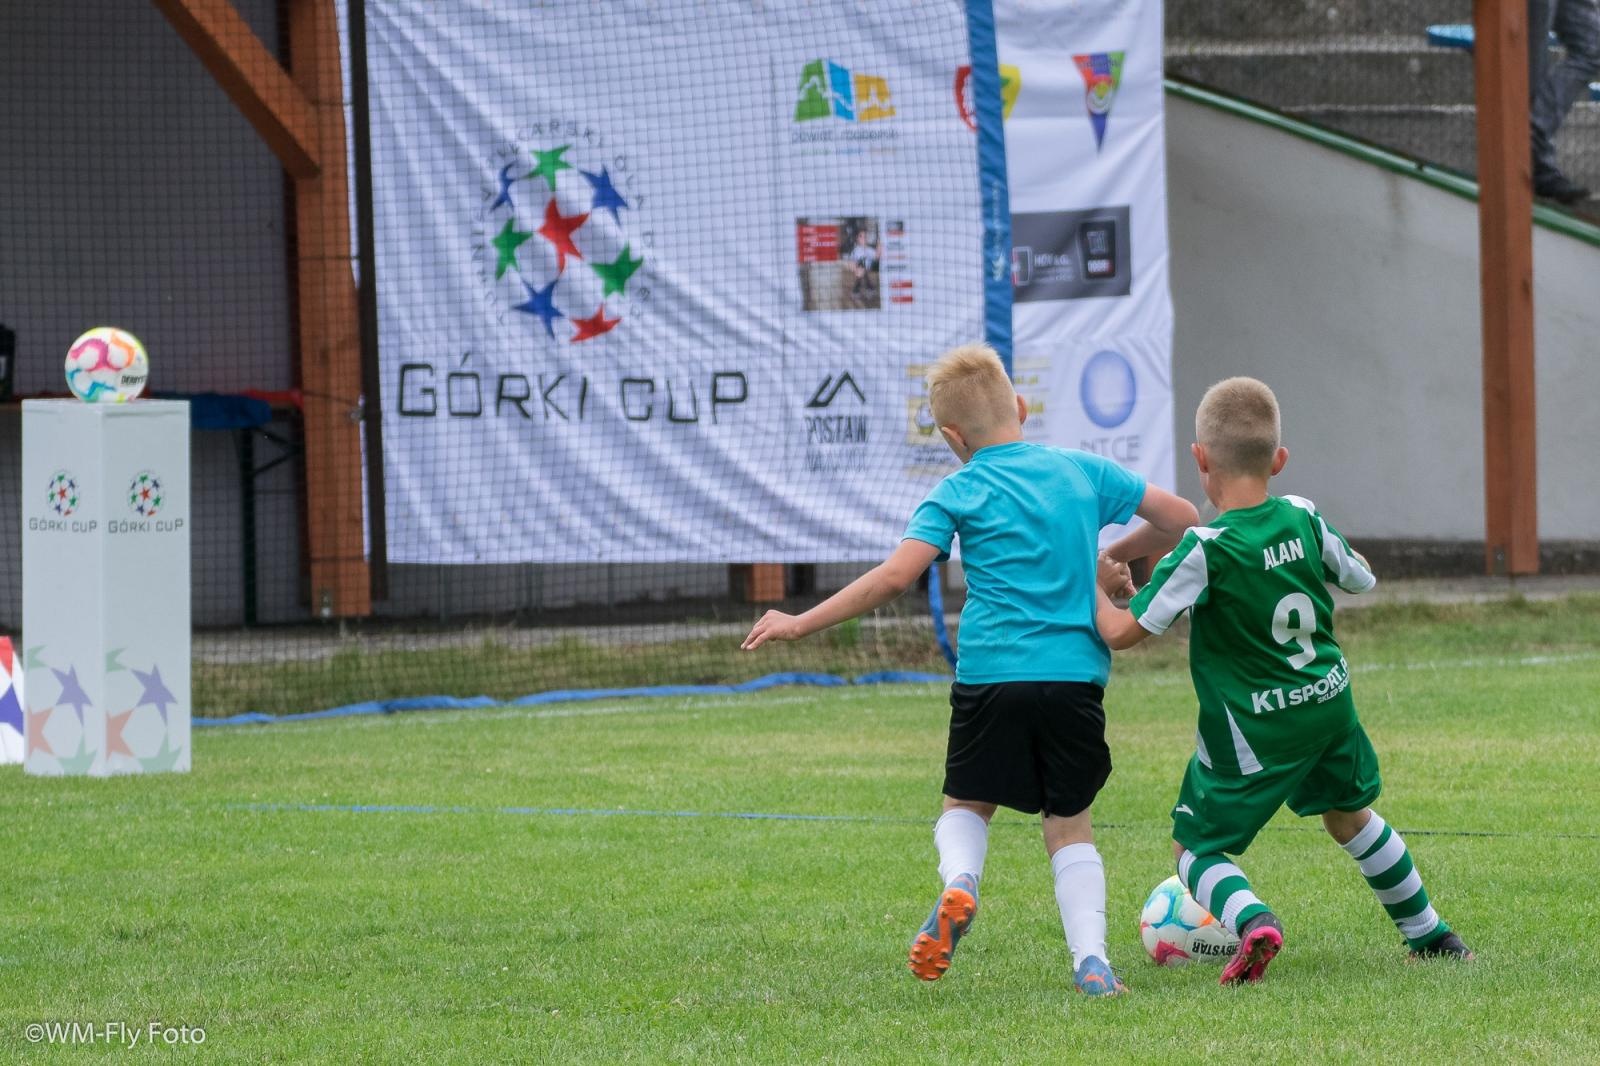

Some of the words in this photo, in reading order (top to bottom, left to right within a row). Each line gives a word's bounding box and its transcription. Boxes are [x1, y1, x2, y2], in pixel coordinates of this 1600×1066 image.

[398, 352, 588, 420] GÓRKI
[621, 371, 749, 424] CUP
[803, 415, 868, 444] POSTAW
[29, 517, 67, 532] GÓRKI
[71, 520, 97, 533] CUP
[108, 518, 150, 534] GÓRKI
[155, 518, 184, 533] CUP
[1262, 537, 1305, 571] ALAN
[1271, 592, 1317, 671] 9
